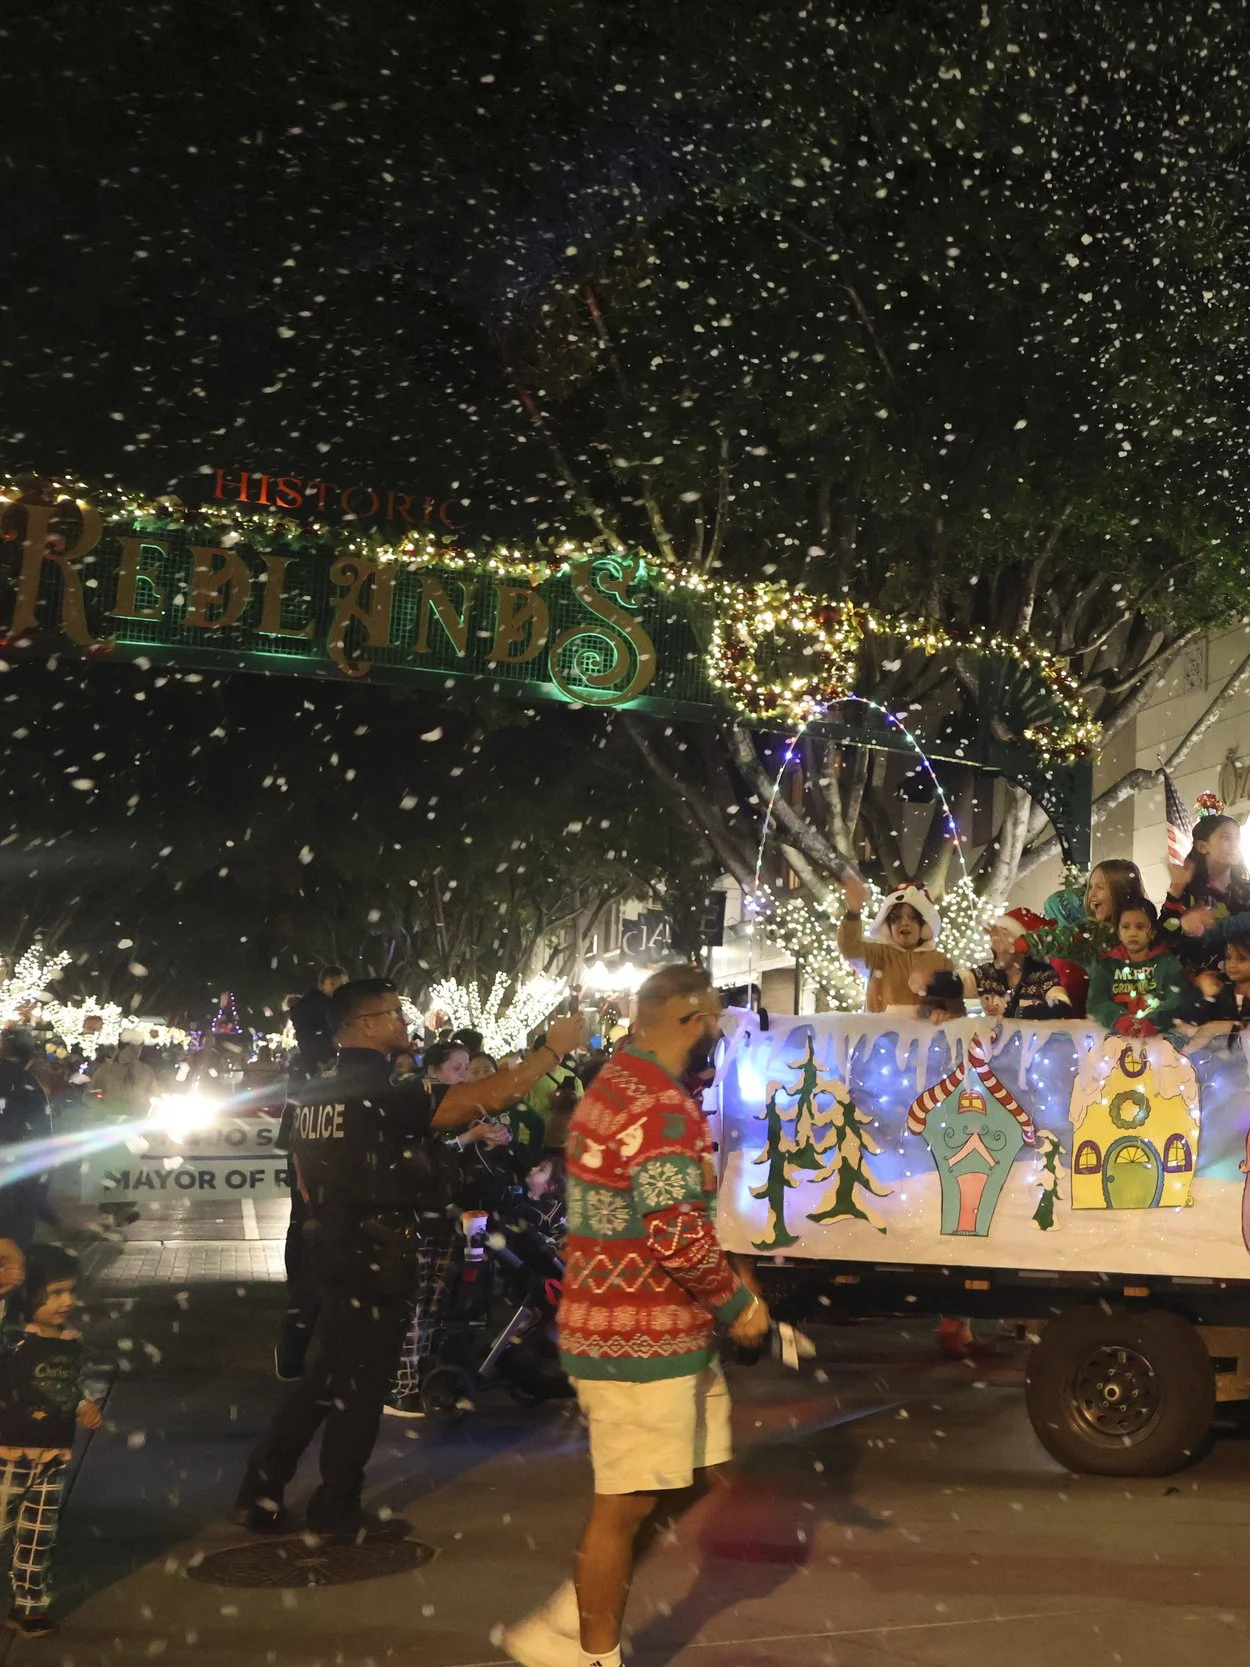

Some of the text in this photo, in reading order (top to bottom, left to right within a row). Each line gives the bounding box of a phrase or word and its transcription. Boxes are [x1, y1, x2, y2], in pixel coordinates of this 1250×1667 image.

[213, 468, 473, 530] HISTORIC
[0, 495, 657, 706] REDLANDS
[103, 1170, 216, 1190] MAYOR
[225, 1170, 265, 1190] OF
